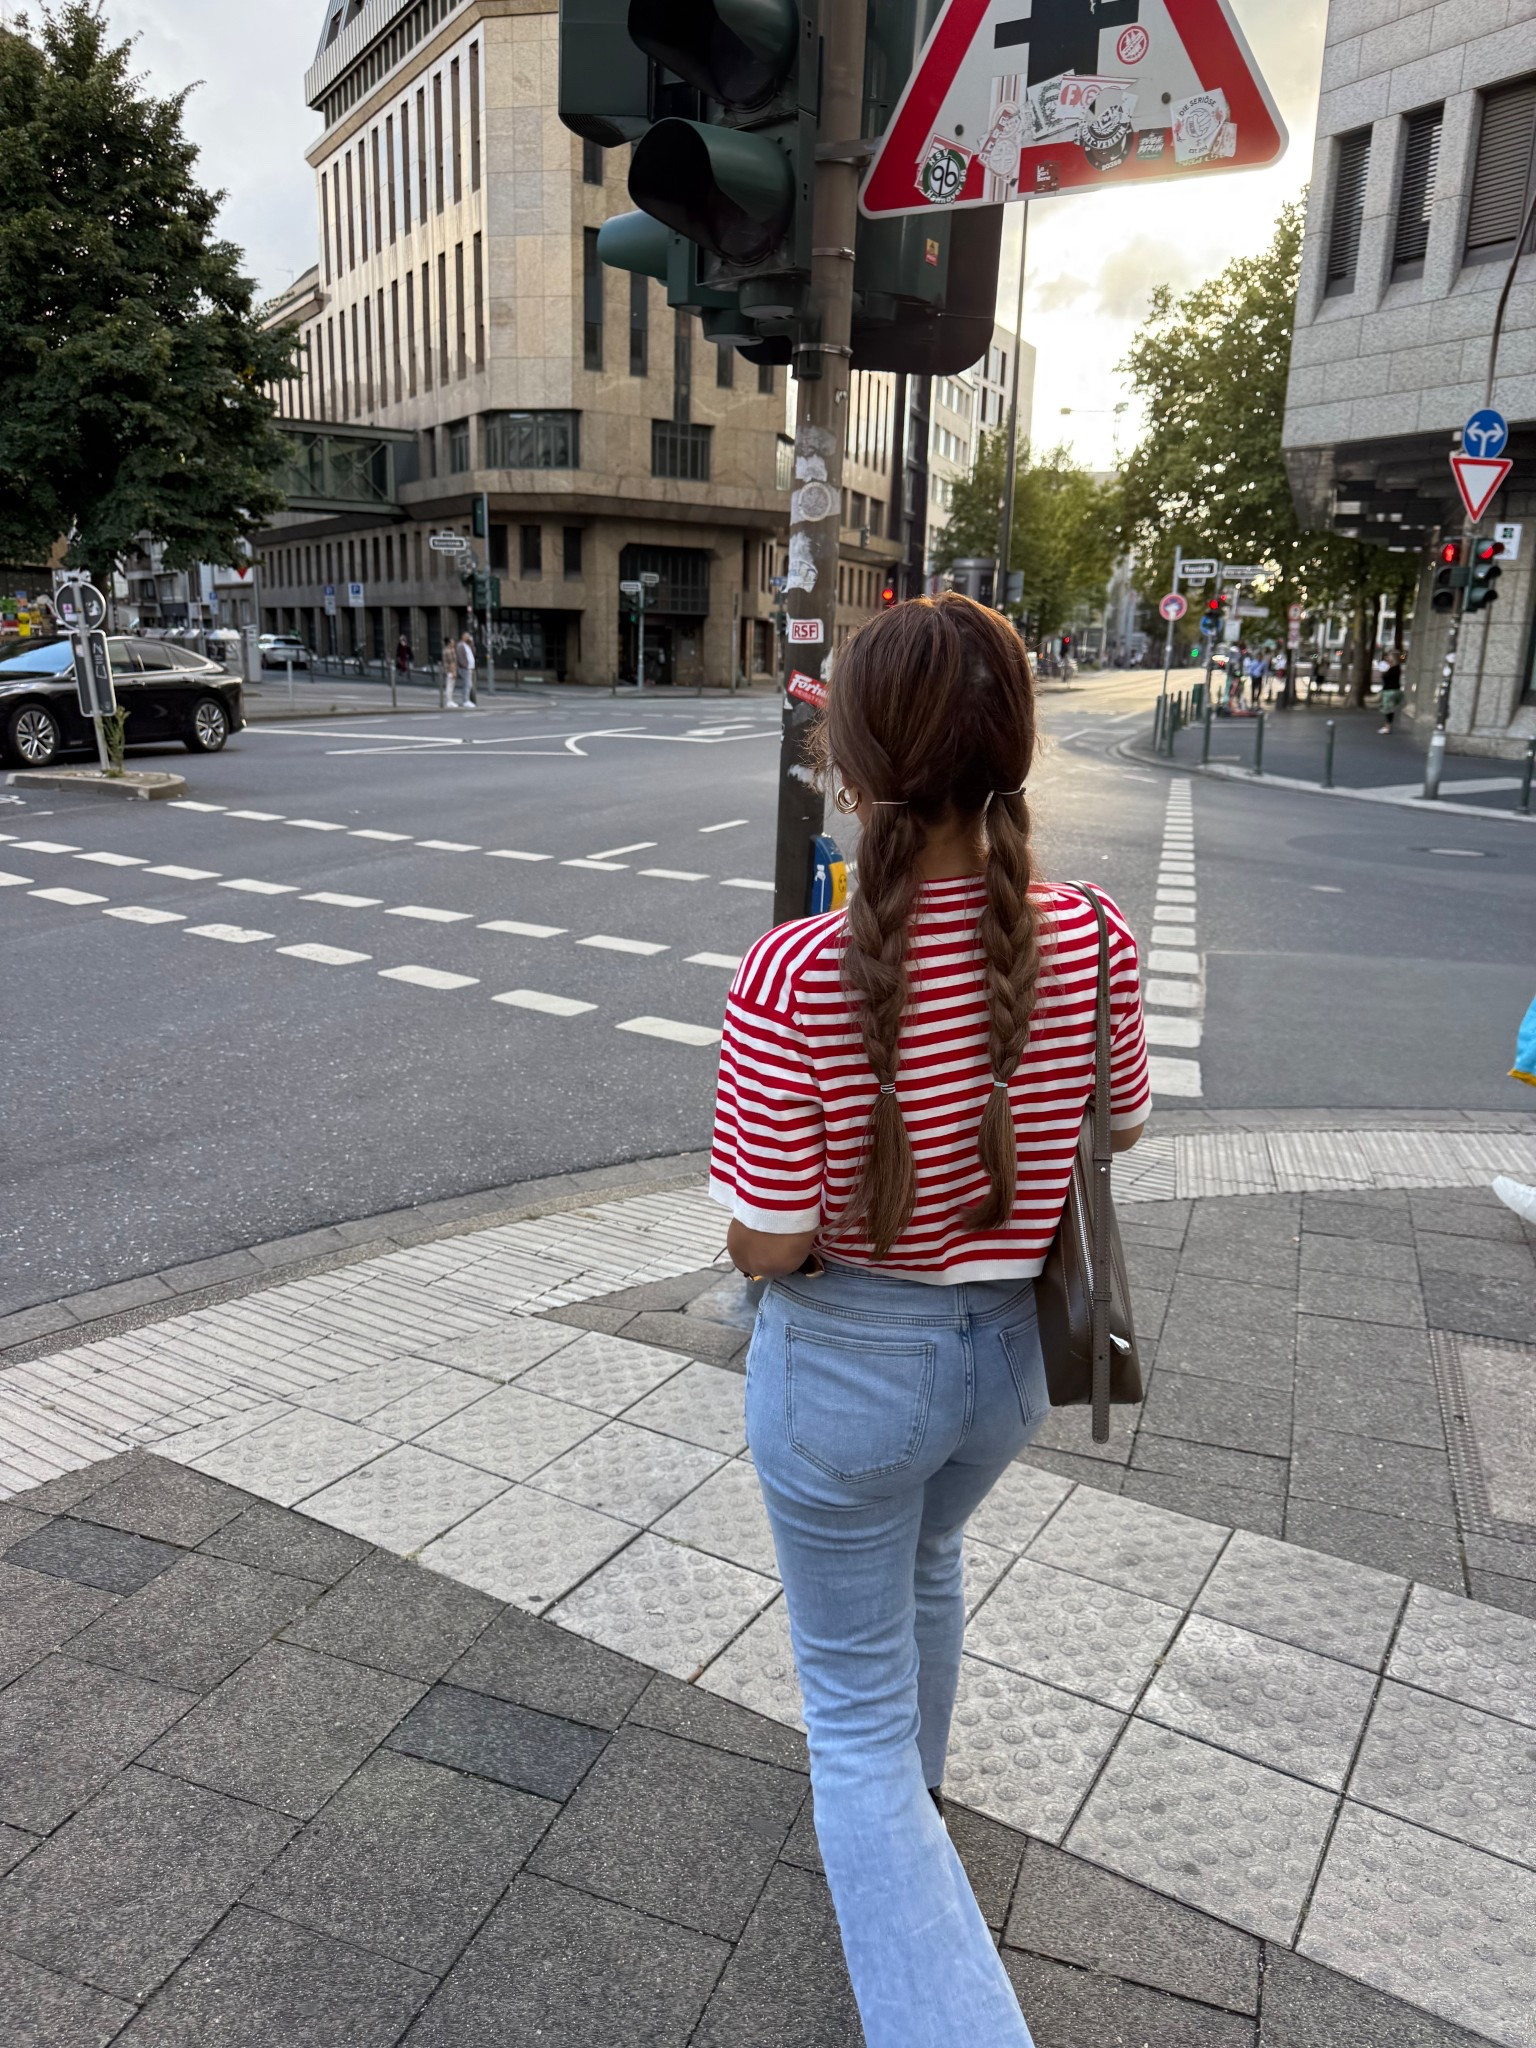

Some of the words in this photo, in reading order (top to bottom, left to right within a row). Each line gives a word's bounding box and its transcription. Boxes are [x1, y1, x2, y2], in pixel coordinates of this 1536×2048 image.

[1179, 104, 1190, 116] DIE
[1189, 95, 1217, 108] SERIÖSE
[928, 149, 949, 166] HSV
[794, 624, 817, 638] RSF
